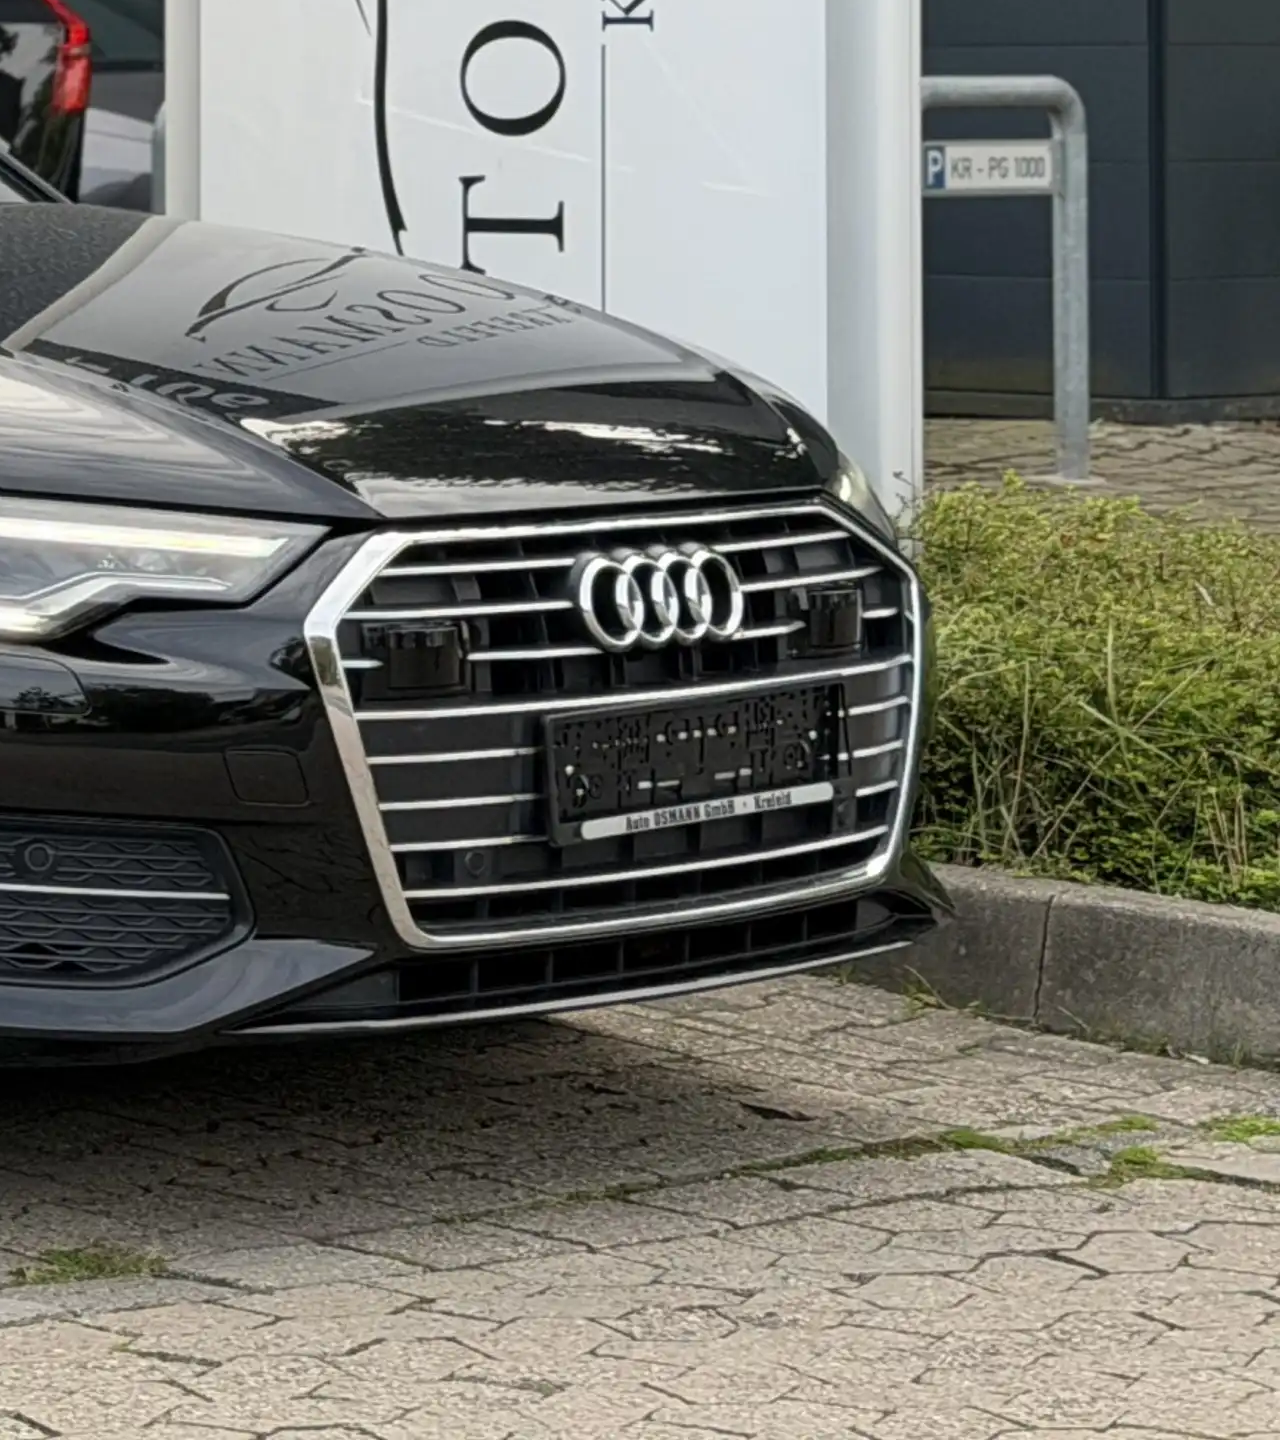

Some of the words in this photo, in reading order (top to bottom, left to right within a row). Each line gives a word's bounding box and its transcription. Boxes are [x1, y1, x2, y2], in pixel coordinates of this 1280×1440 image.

[458, 19, 567, 275] TO
[926, 149, 944, 186] P
[950, 156, 972, 180] KR
[653, 805, 700, 827] OSMANN
